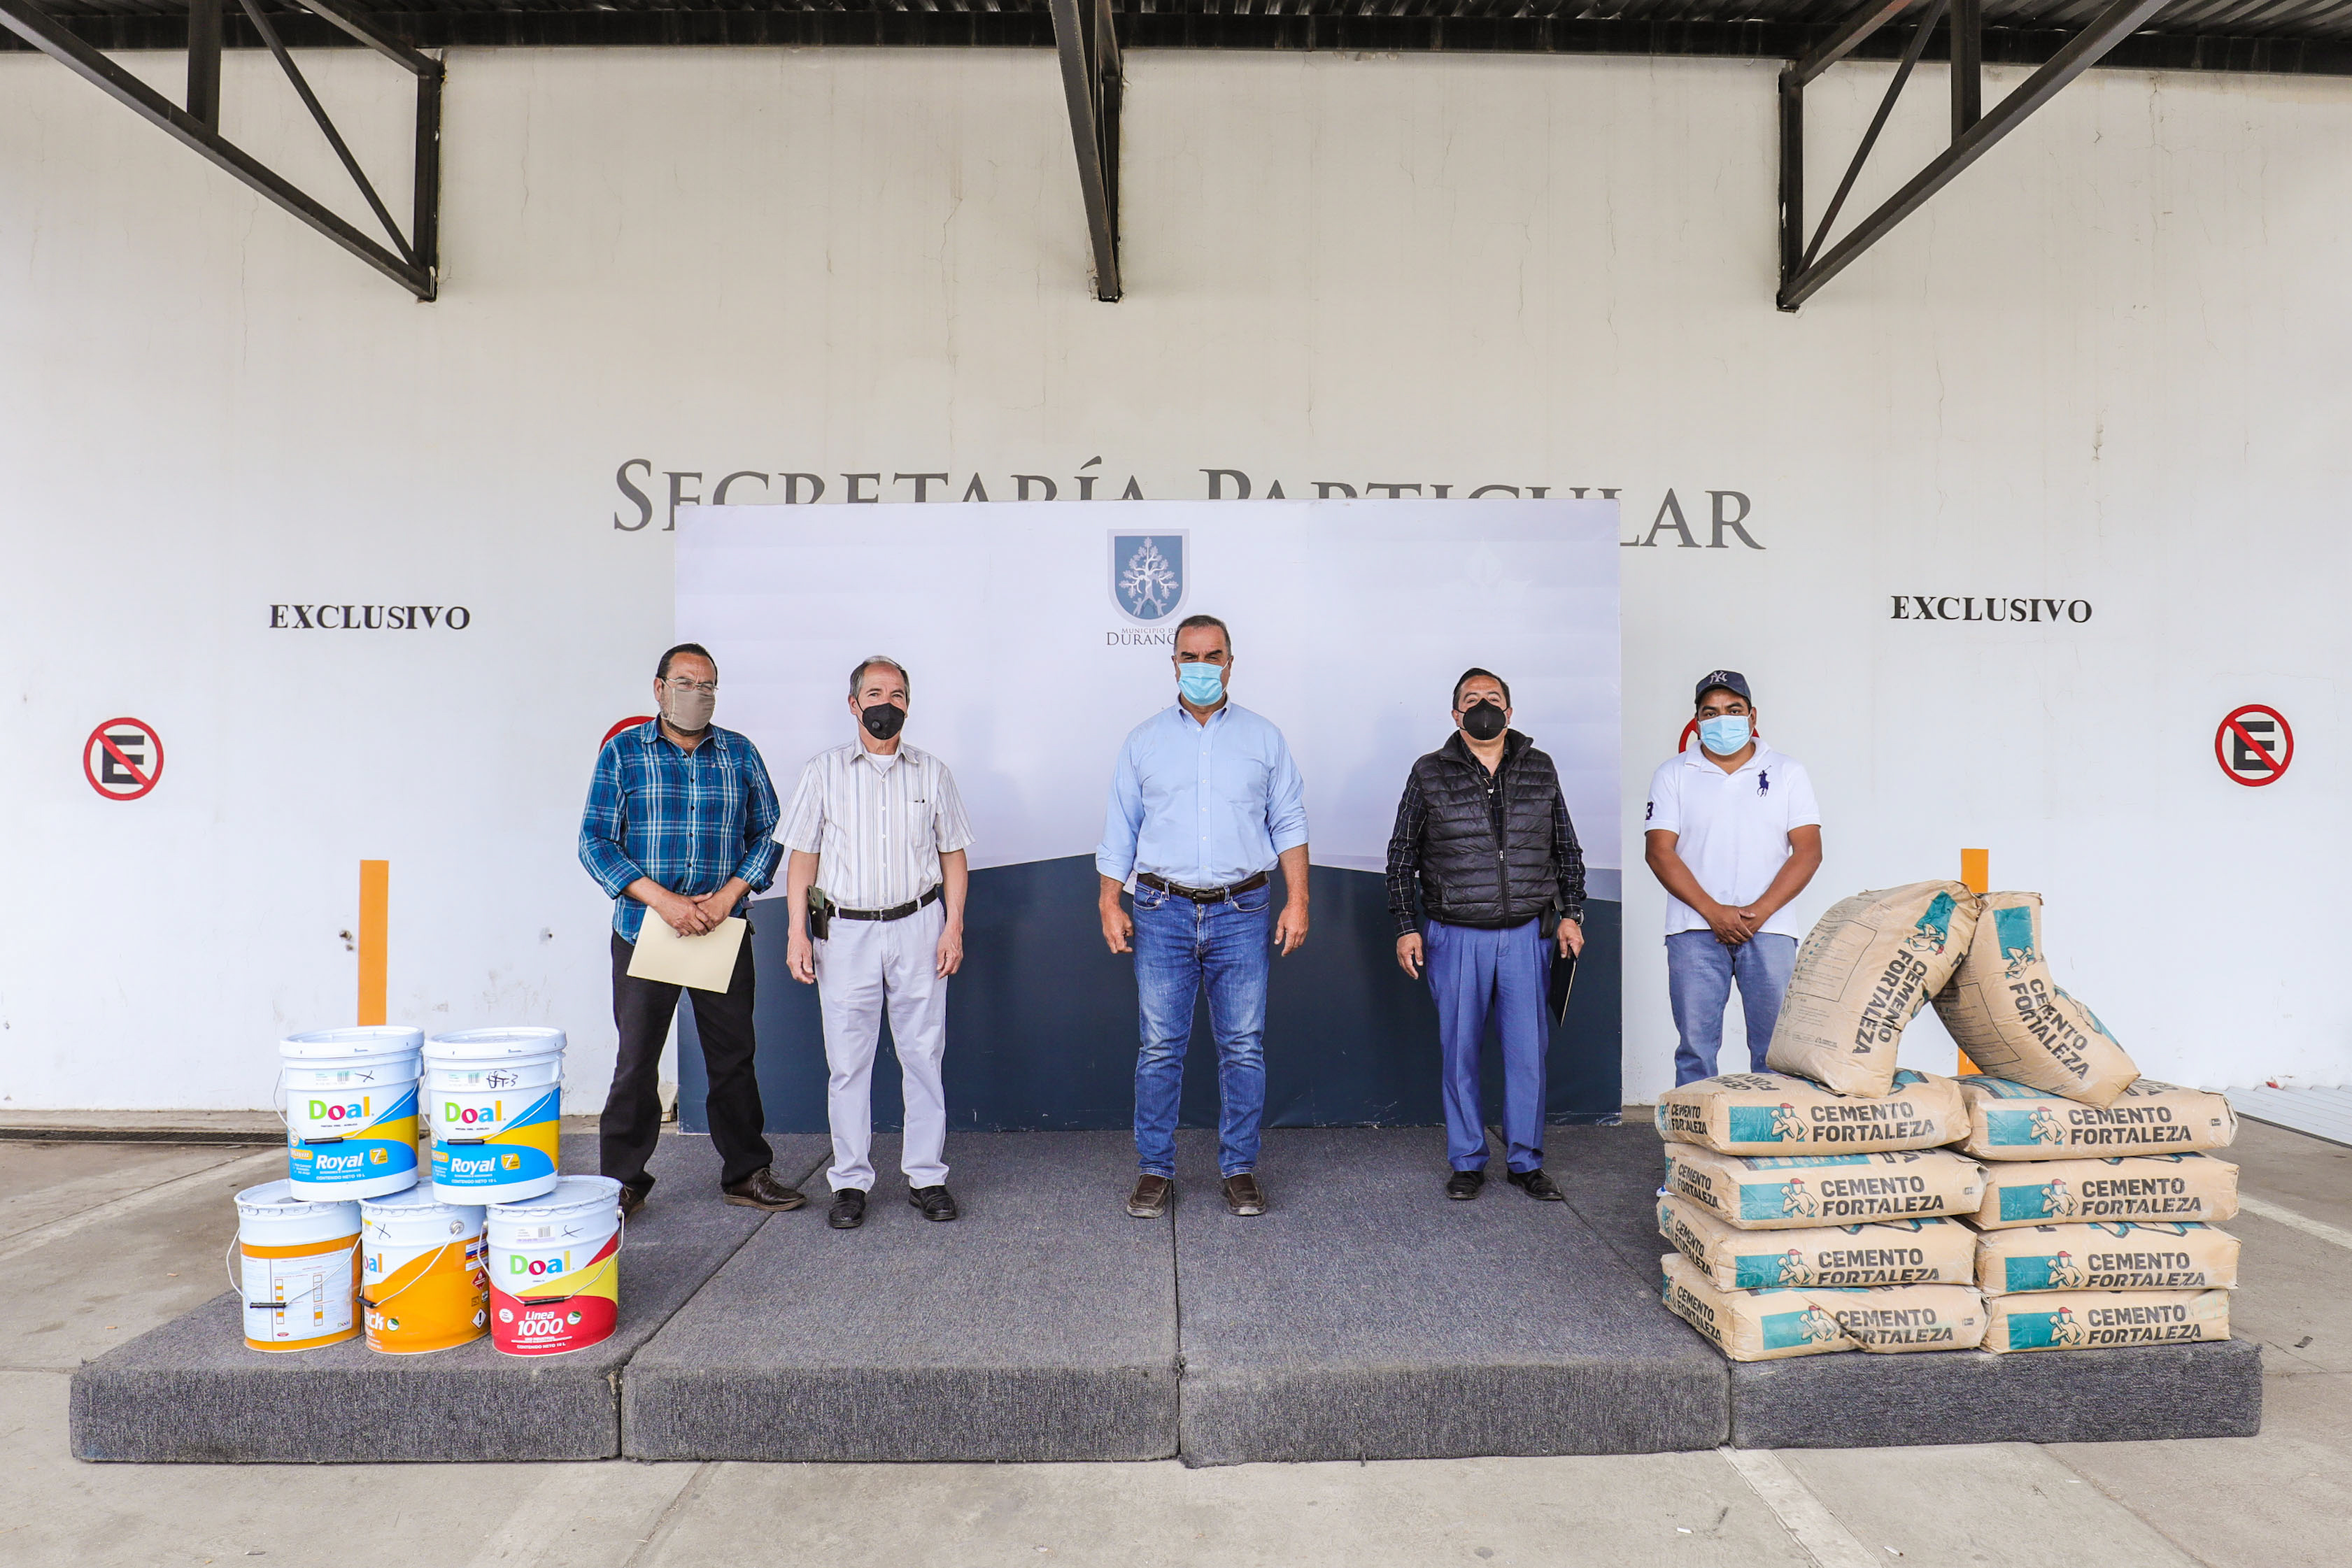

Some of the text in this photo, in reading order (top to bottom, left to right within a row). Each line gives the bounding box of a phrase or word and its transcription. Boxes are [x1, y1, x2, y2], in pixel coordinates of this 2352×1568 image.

[269, 604, 471, 630] EXCLUSIVO
[1890, 595, 2093, 623] EXCLUSIVO
[1852, 948, 1914, 1054] FORTALEZA
[309, 1096, 370, 1120] Doal
[445, 1100, 502, 1124] Doal
[1671, 1104, 1701, 1119] CEMENTO
[1811, 1102, 1914, 1122] CEMENTO
[2068, 1106, 2172, 1125] CEMENTO
[1813, 1119, 1935, 1142] FORTALEZA
[2071, 1125, 2192, 1145] FORTALEZA
[316, 1153, 364, 1171] Royal
[371, 1149, 383, 1163] 7
[504, 1155, 514, 1169] 7
[451, 1157, 496, 1176] Royal
[1678, 1164, 1712, 1191] CEMENTO
[1820, 1176, 1925, 1197] CEMENTO
[2081, 1177, 2185, 1197] CEMENTO
[1677, 1178, 1721, 1209] FORTALEZA
[1822, 1195, 1944, 1216] FORTALEZA
[2081, 1197, 2202, 1216] FORTALEZA
[1676, 1220, 1705, 1257] CEMENTO
[364, 1253, 383, 1273] oal
[510, 1250, 571, 1276] Doal
[1818, 1248, 1923, 1269] CEMENTO
[2088, 1252, 2190, 1271] CEMENTO
[1817, 1268, 1939, 1285] FORTALEZA
[2085, 1272, 2205, 1288] FORTALEZA
[1677, 1285, 1714, 1322] CEMENTO
[1836, 1308, 1936, 1327] CEMENTO
[2088, 1304, 2186, 1327] CEMENTO
[518, 1318, 563, 1336] 1000
[2088, 1324, 2202, 1344] FORTALEZA
